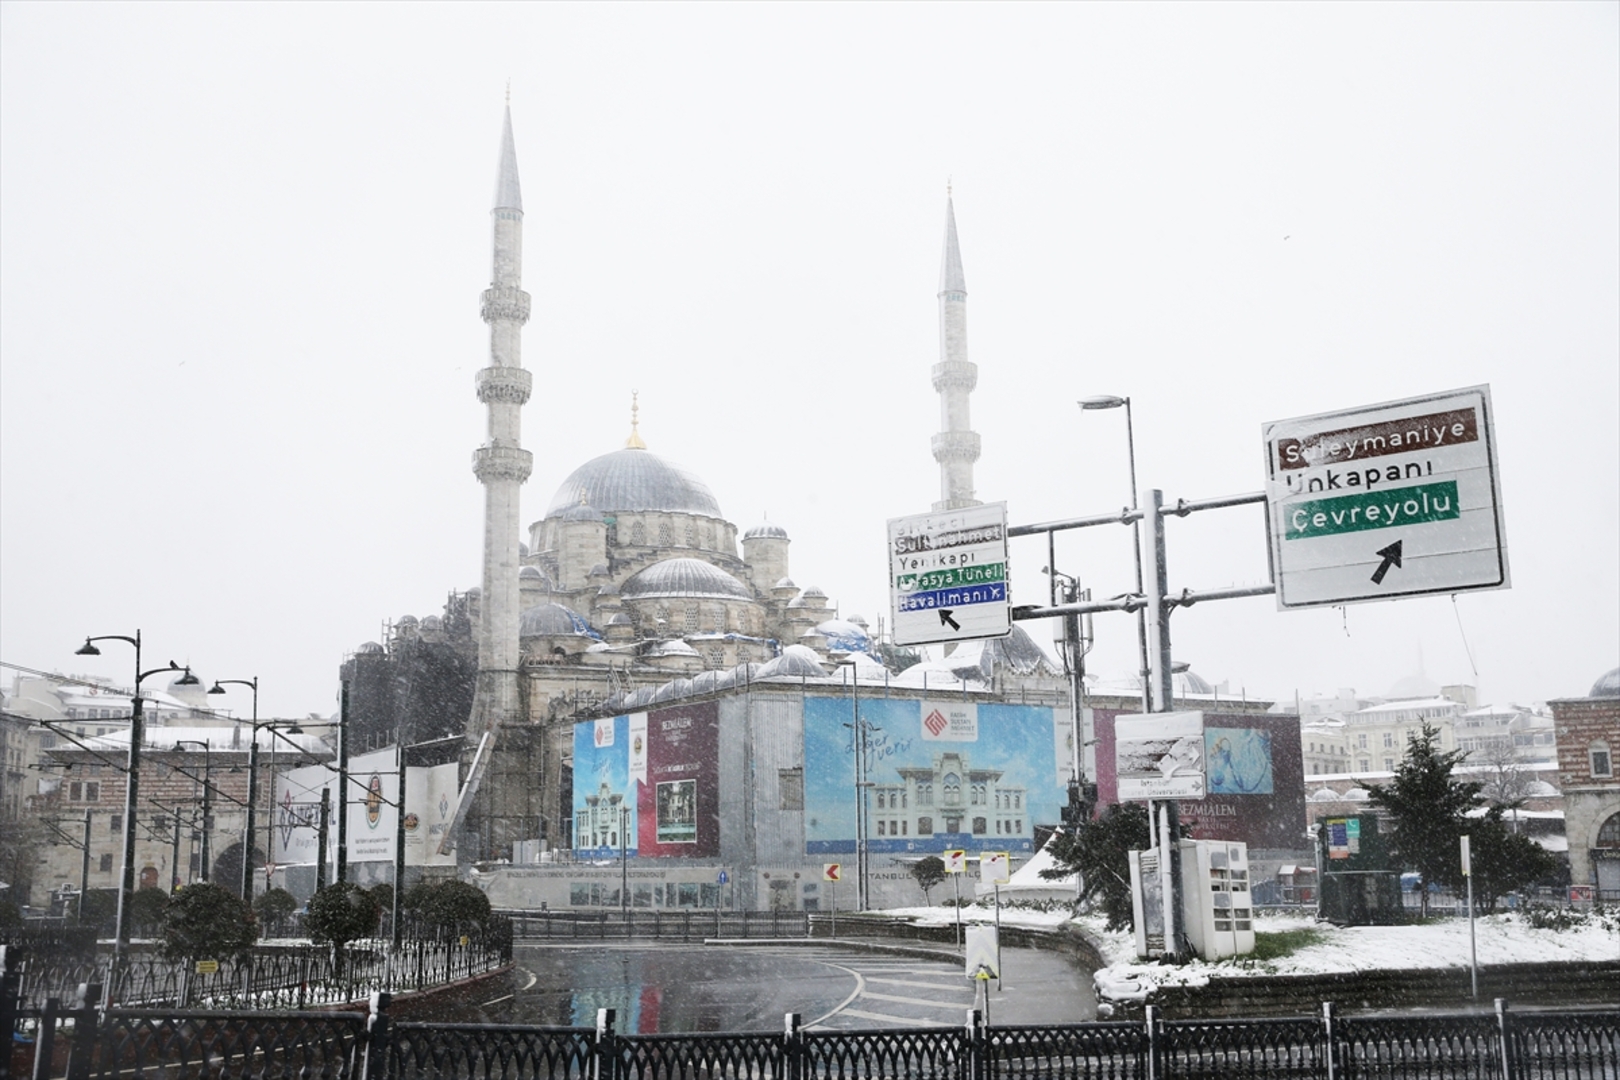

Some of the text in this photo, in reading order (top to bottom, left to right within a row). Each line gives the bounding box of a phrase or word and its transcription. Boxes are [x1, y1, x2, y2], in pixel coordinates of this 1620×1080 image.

[1292, 493, 1450, 532] Çevreyolu
[897, 514, 966, 536] Sikeci
[897, 527, 1000, 551] Sultnahmet
[900, 565, 1003, 587] Arasya Tüneli
[899, 590, 988, 610] Havalimanı
